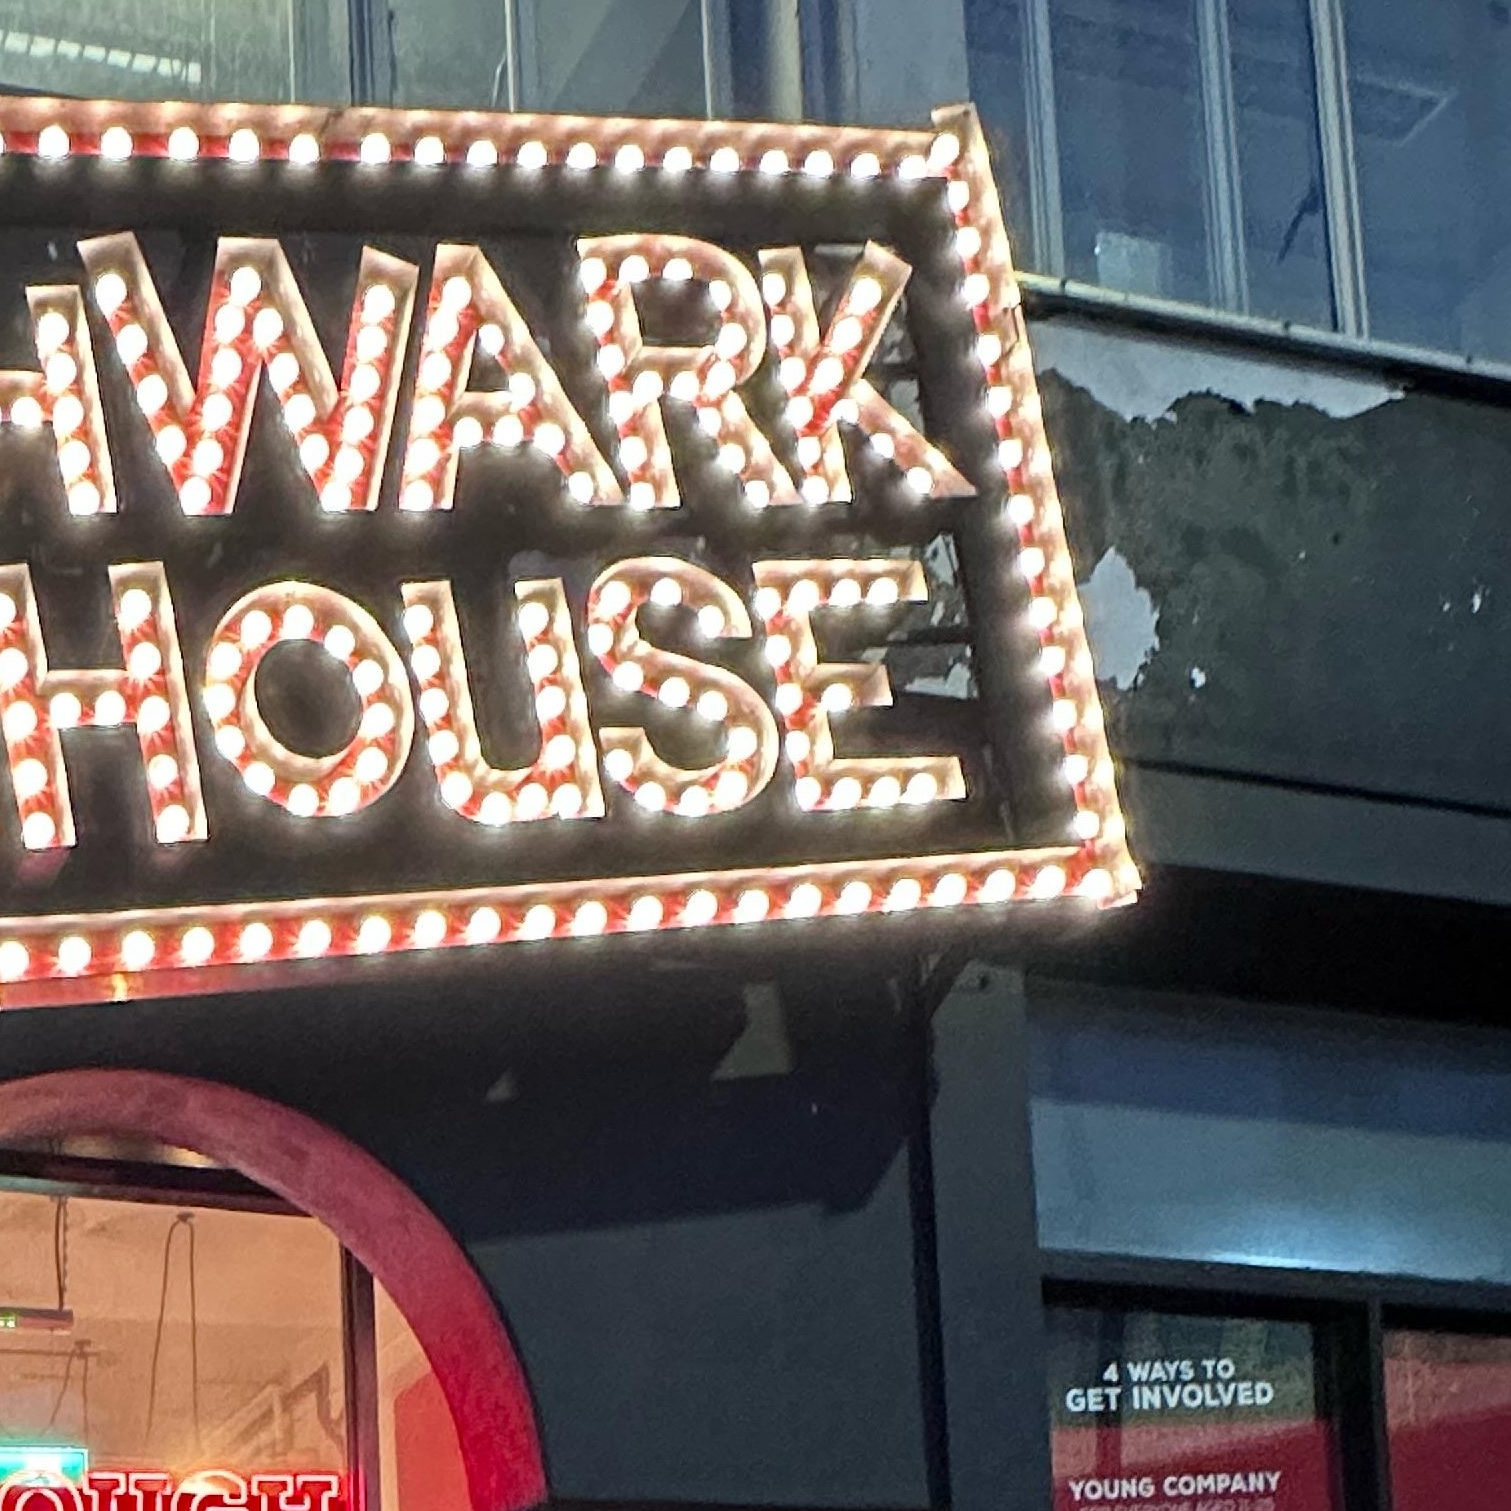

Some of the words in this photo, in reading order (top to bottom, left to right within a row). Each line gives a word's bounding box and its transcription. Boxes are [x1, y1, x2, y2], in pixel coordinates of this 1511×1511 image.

[1102, 1361, 1120, 1382] 4
[1126, 1359, 1195, 1382] WAYS
[1201, 1357, 1235, 1380] TO
[1065, 1386, 1122, 1412] GET
[1132, 1381, 1274, 1410] INVOLVED
[1068, 1476, 1156, 1501] YOUNG
[1163, 1470, 1282, 1497] COMPANY
